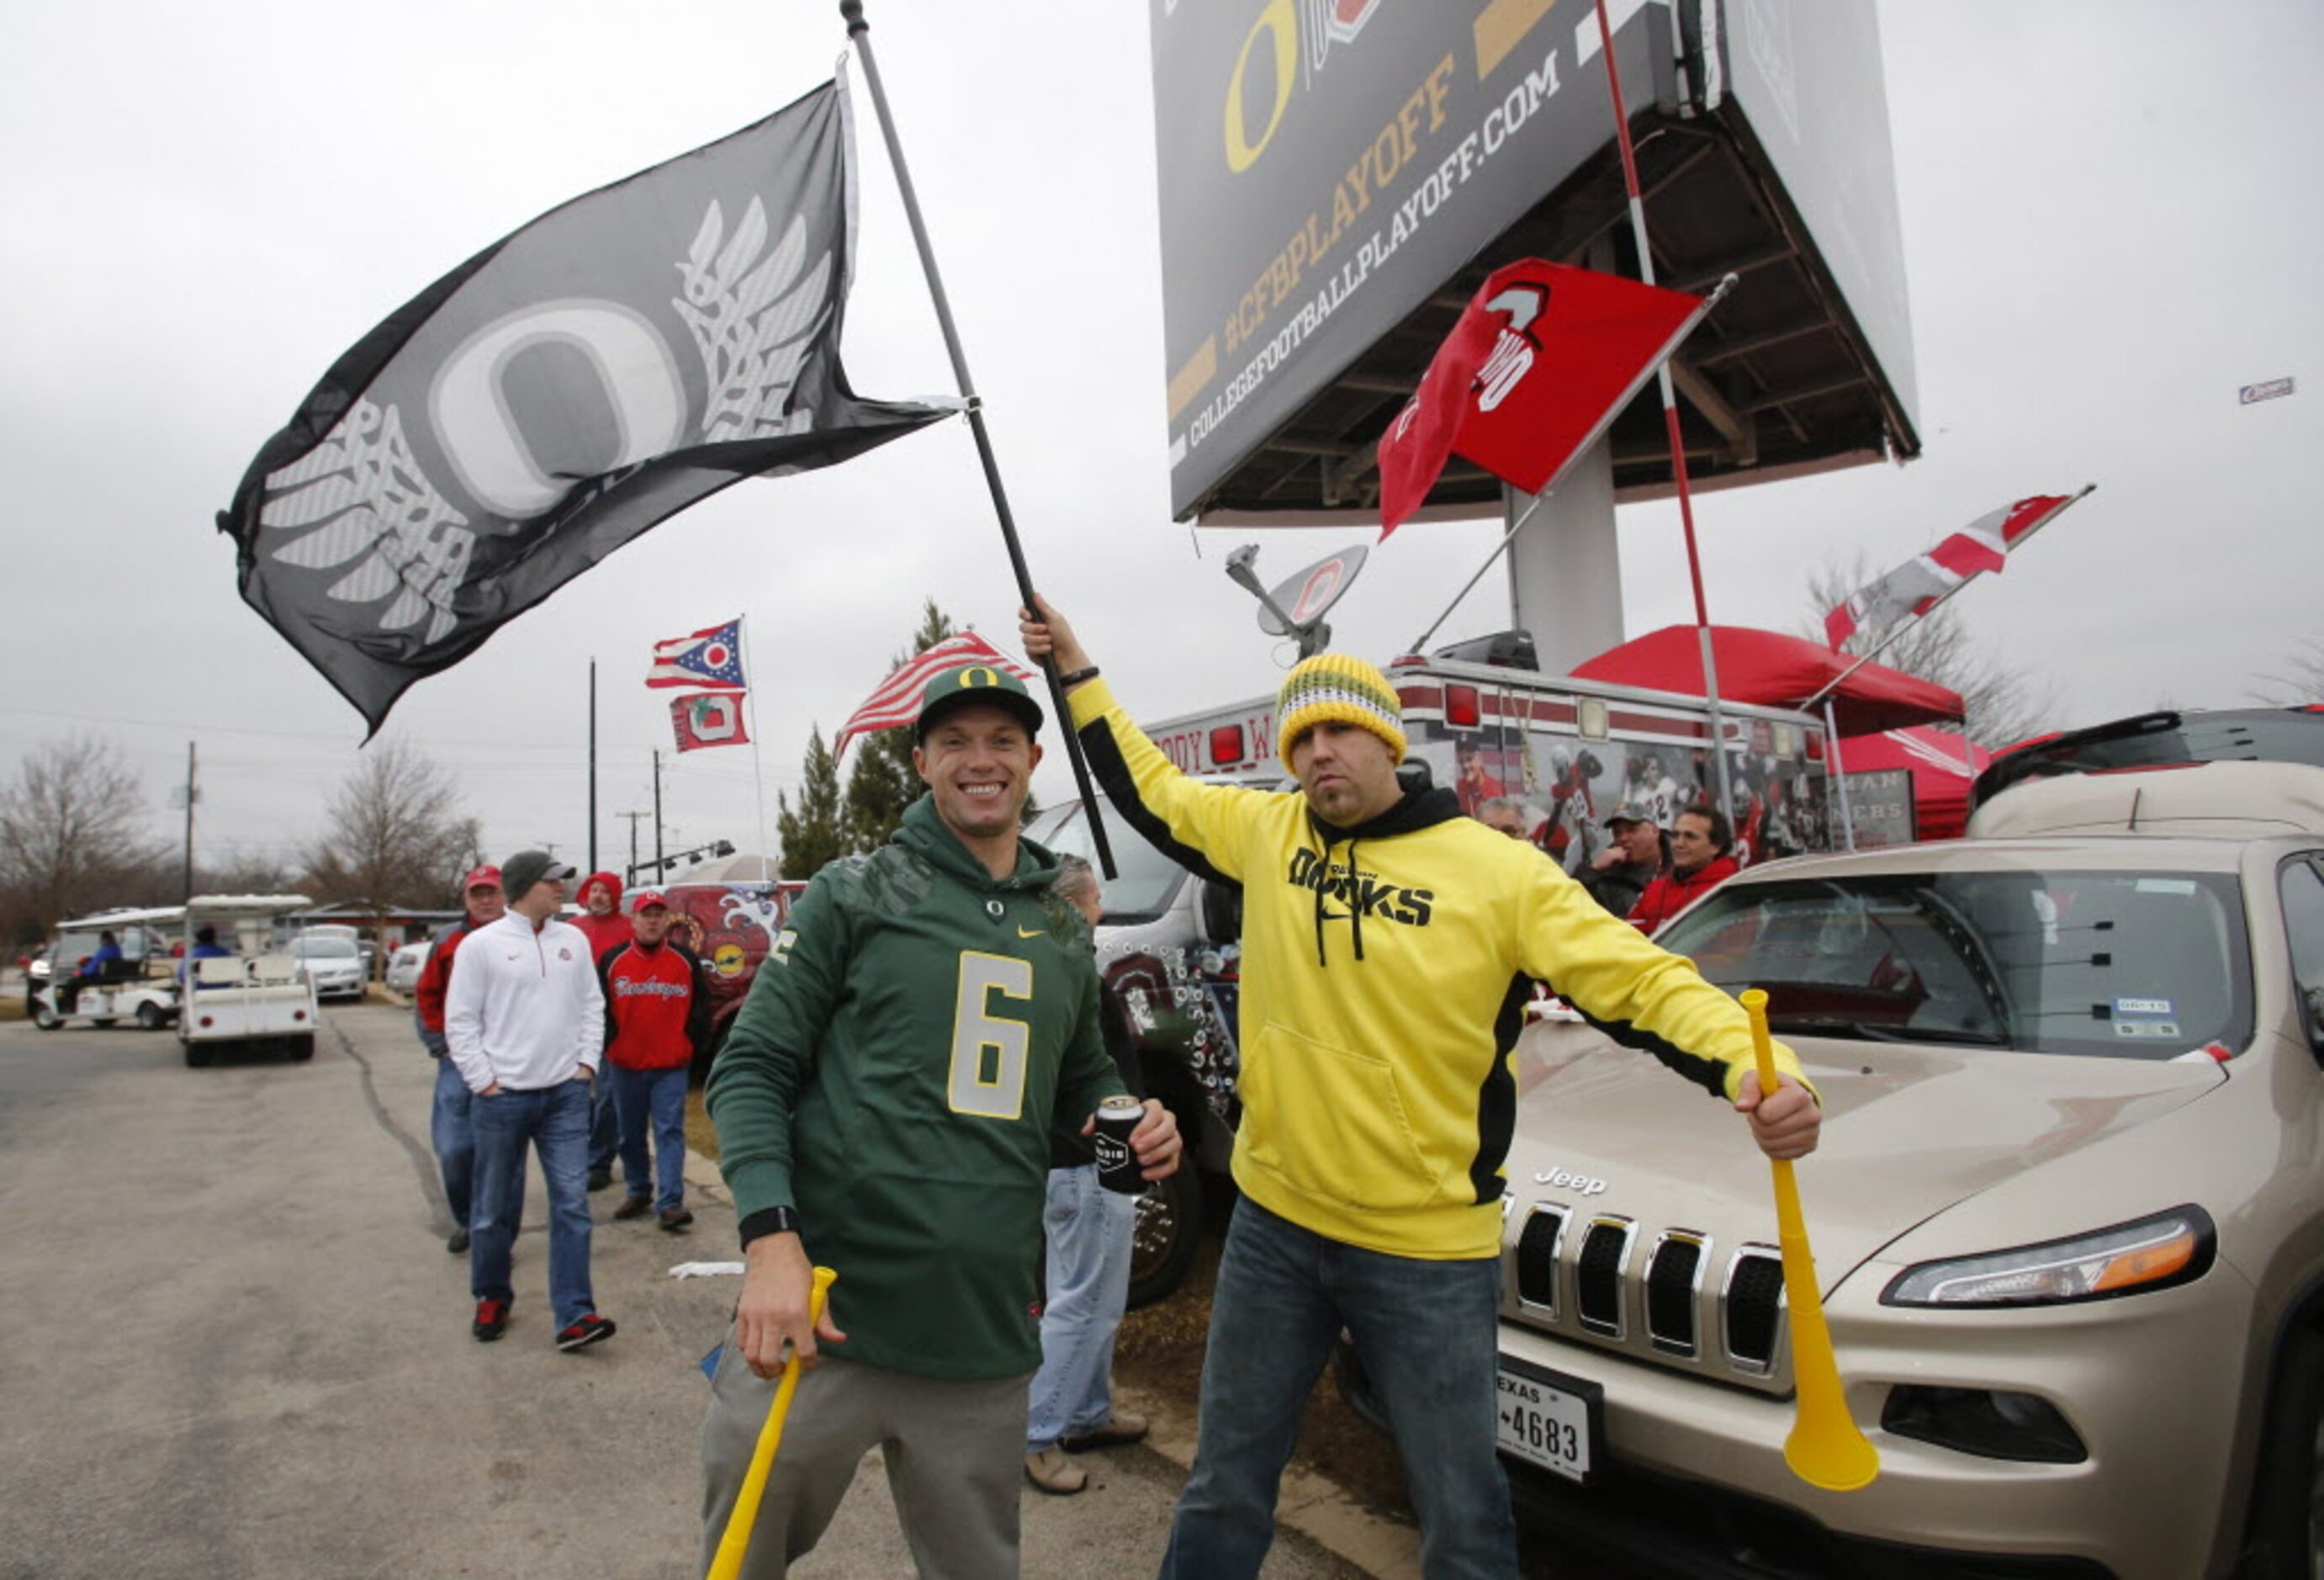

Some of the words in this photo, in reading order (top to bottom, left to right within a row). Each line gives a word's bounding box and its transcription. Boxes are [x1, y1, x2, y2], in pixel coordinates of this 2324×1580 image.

[1190, 48, 1562, 448] COLLEGEFOOTBALLPLAYOFF.COM
[1222, 52, 1457, 358] #CFBPLAYOFF
[948, 949, 1033, 1121] 6
[1534, 1166, 1607, 1196] Jeep
[1497, 1376, 1541, 1403] EXAS
